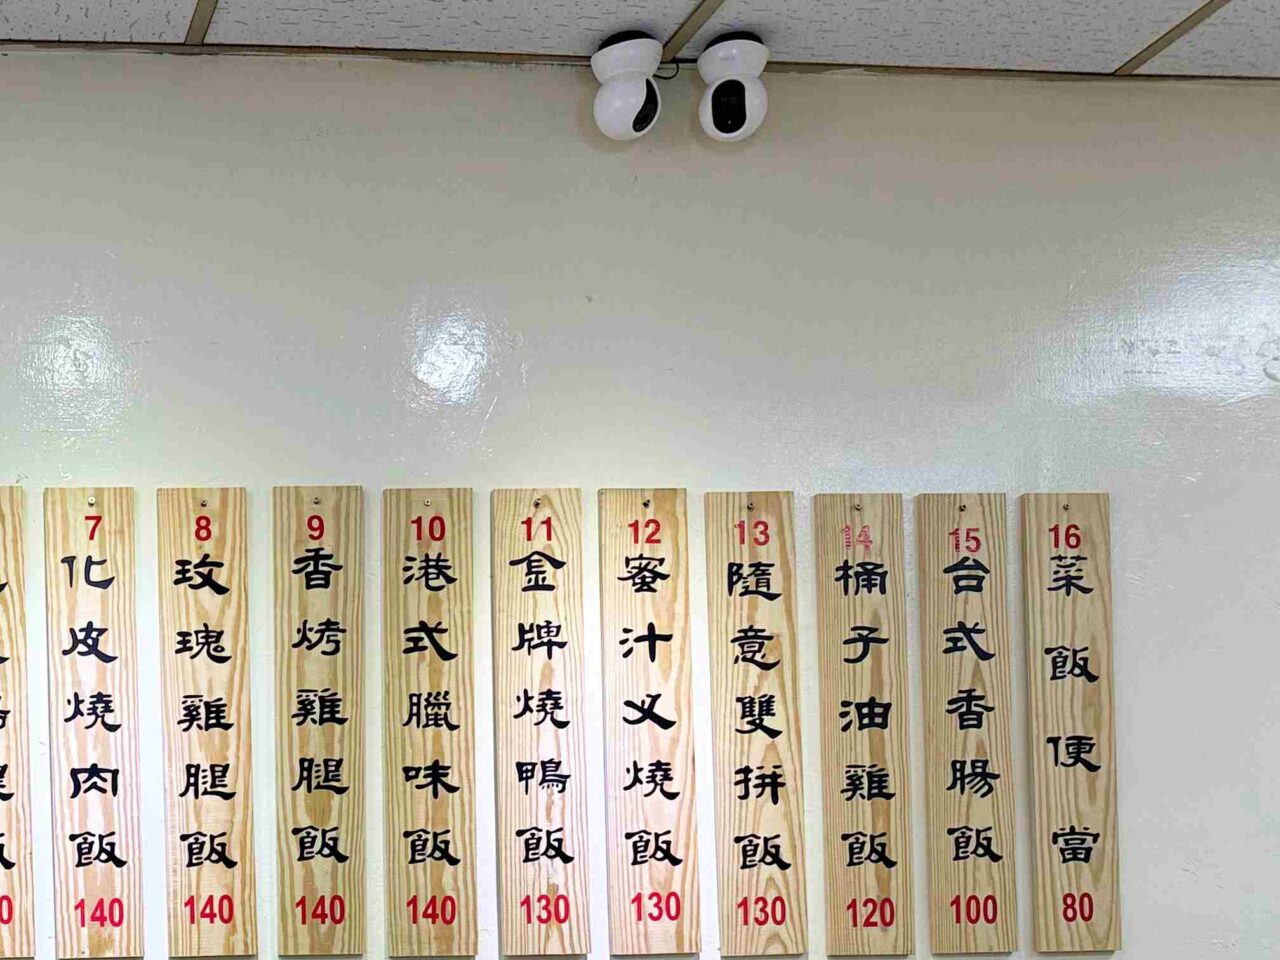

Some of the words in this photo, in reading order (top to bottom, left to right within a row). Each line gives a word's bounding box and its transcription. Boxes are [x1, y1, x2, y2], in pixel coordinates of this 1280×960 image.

[84, 513, 103, 541] 7
[194, 513, 213, 544] 8
[306, 513, 325, 541] 9
[410, 514, 447, 542] 10
[522, 516, 553, 542] 11
[629, 517, 662, 546] 12
[736, 519, 771, 547] 13
[1052, 524, 1081, 549] 16
[60, 555, 128, 868] 化皮燒肉飯
[173, 553, 238, 869] 玫瑰雞腿飯
[291, 547, 350, 864] 香烤雞腿飯
[508, 550, 575, 865] 金牌燒鴨飯
[834, 558, 898, 869] 桶子油雞飯
[942, 556, 1004, 863] 台式香腸飯
[1044, 554, 1102, 864] 菜飯便當
[73, 895, 125, 931] 140
[183, 892, 236, 927] 140
[294, 893, 347, 926] 140
[406, 894, 458, 927] 140
[519, 892, 571, 926] 130
[629, 889, 683, 924] 130
[735, 894, 787, 927] 130
[847, 896, 896, 929] 120
[949, 894, 999, 925] 100
[1062, 892, 1093, 923] 80
